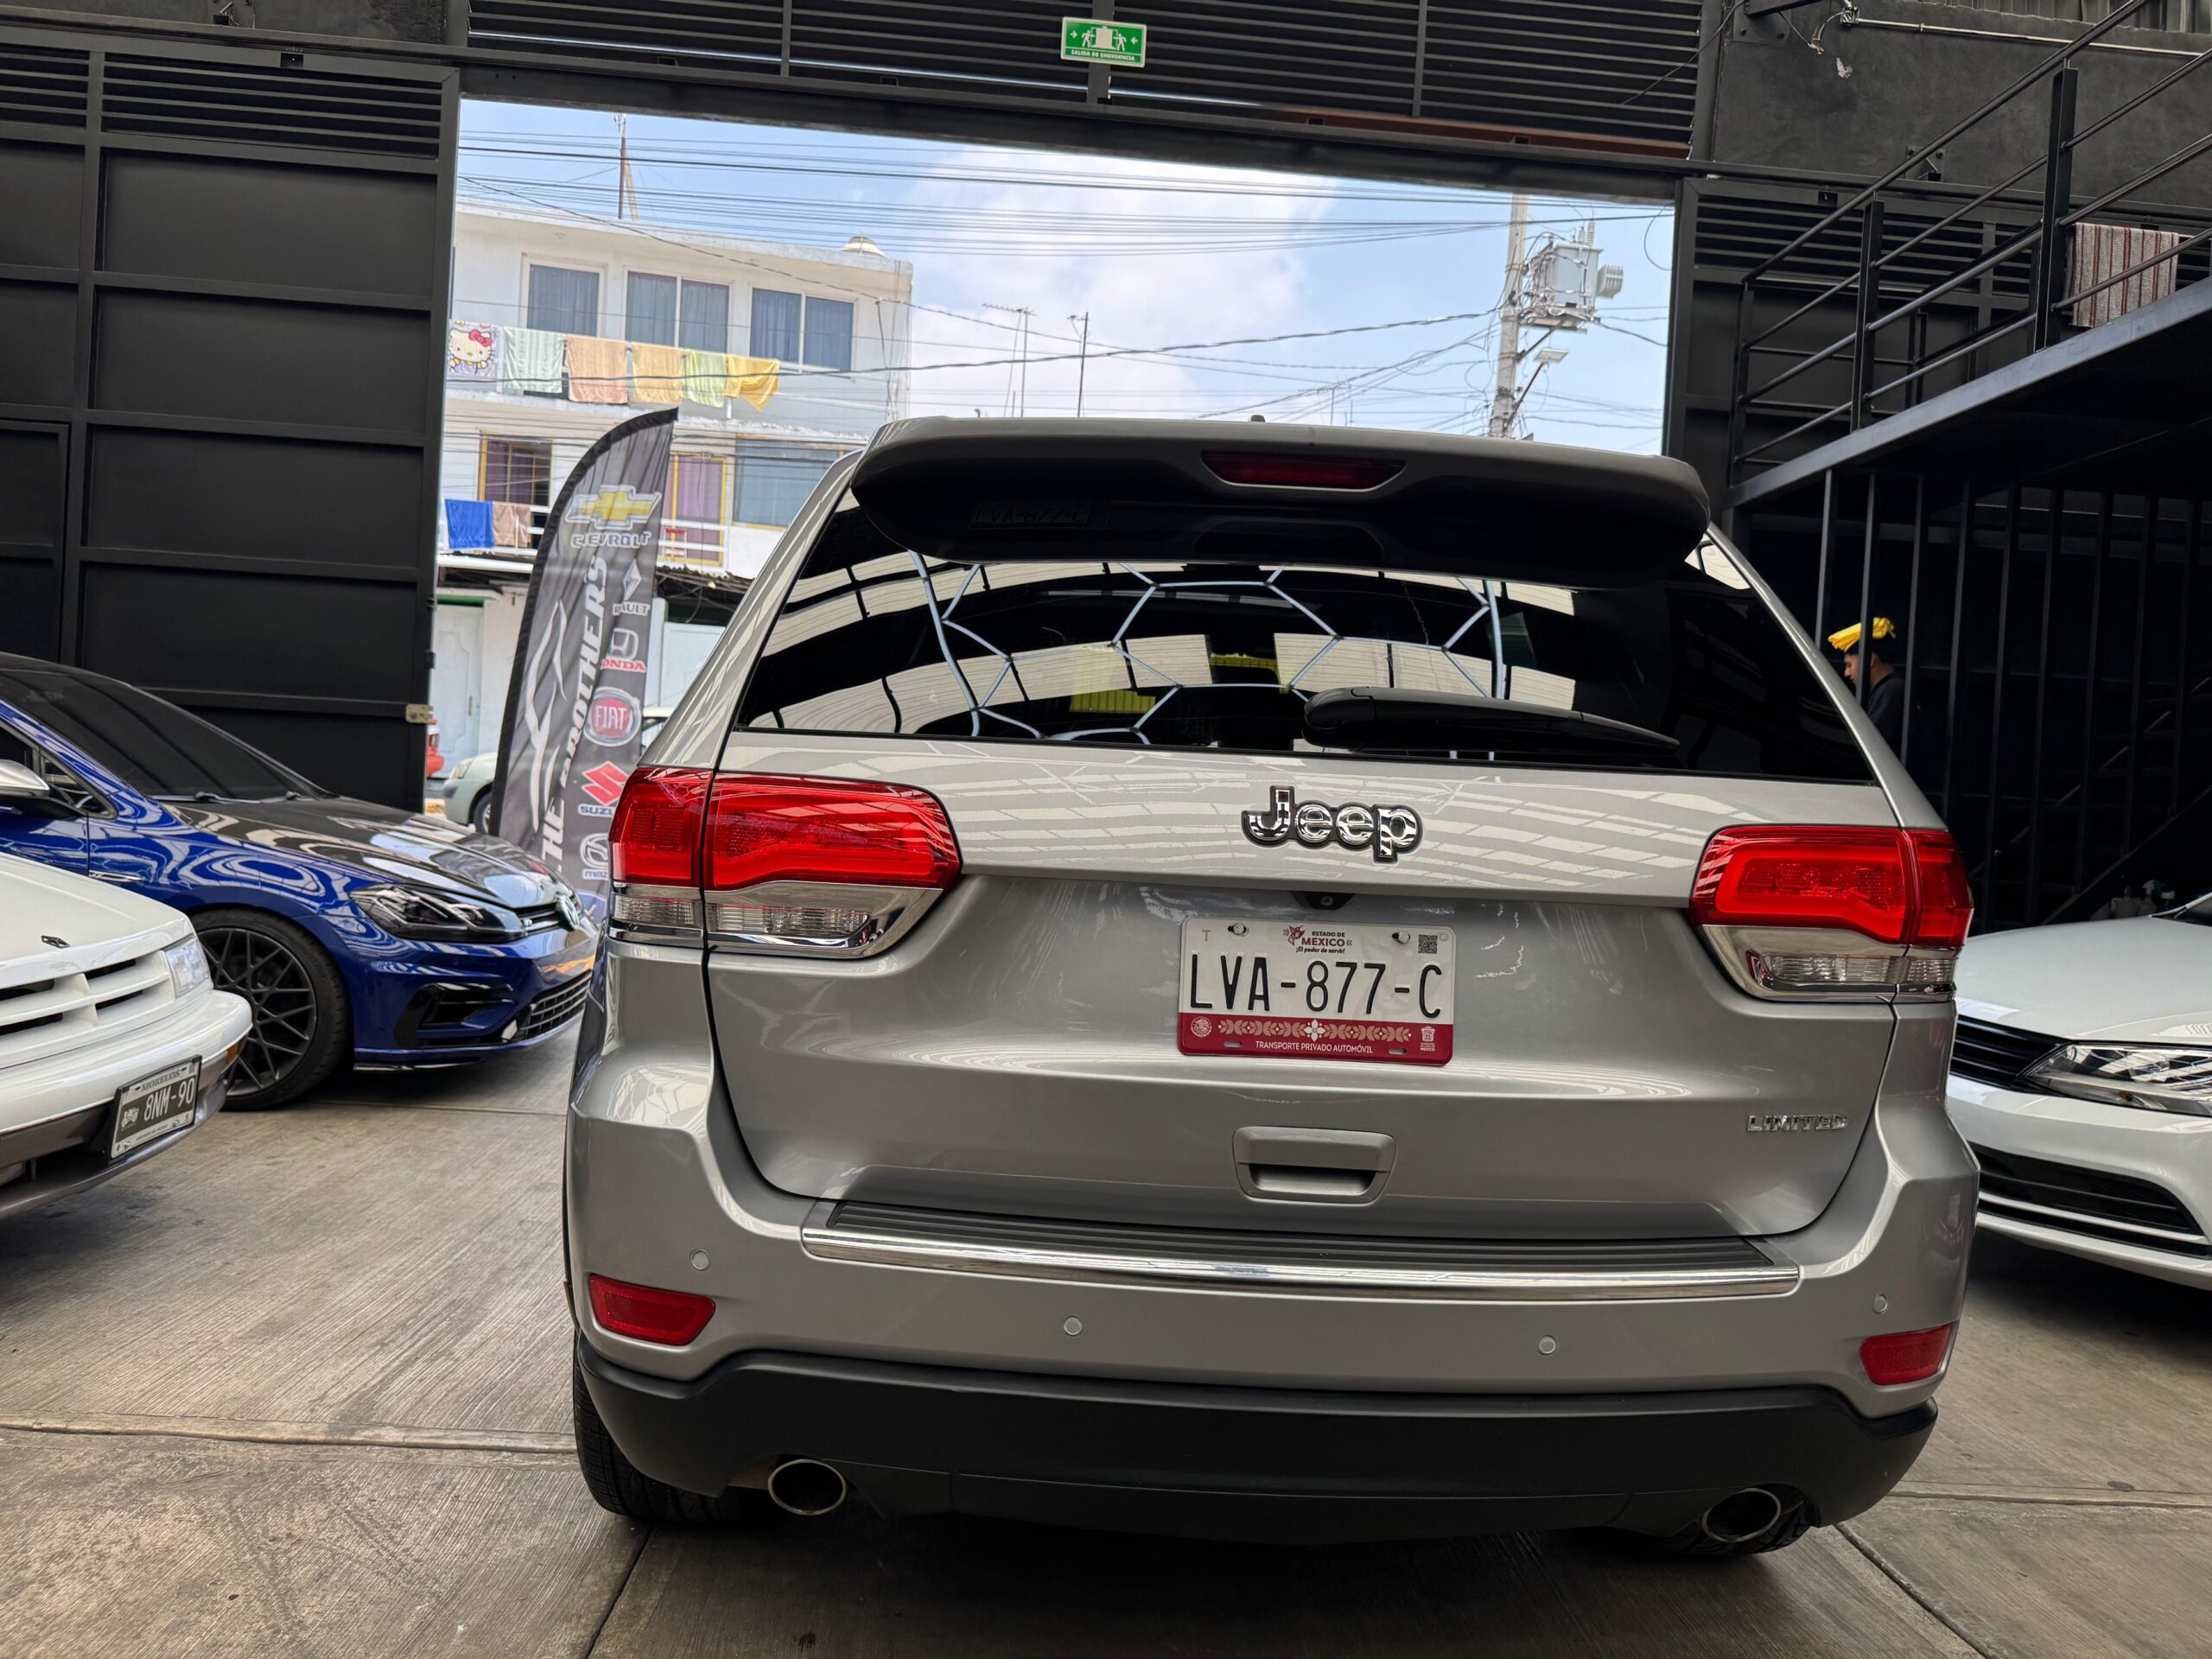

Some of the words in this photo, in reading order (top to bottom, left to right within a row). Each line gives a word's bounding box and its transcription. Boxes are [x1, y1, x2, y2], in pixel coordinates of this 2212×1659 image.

[1100, 52, 1135, 61] EMERGENCIA
[560, 556, 607, 789] BROTHERS
[601, 658, 647, 673] ONDA
[594, 704, 627, 730] FIAT
[1243, 786, 1422, 862] Jeep
[1202, 930, 1211, 942] T
[1190, 954, 1442, 1019] LVA-877-C
[1255, 1040, 1300, 1051] TRANSPORTE
[1300, 1042, 1332, 1052] PRIVADO
[1332, 1044, 1374, 1054] AUTOMÓVIL
[141, 1070, 181, 1092] MORELOS
[143, 1077, 195, 1121] 8NM-90
[1747, 1114, 1848, 1132] LIMITED
